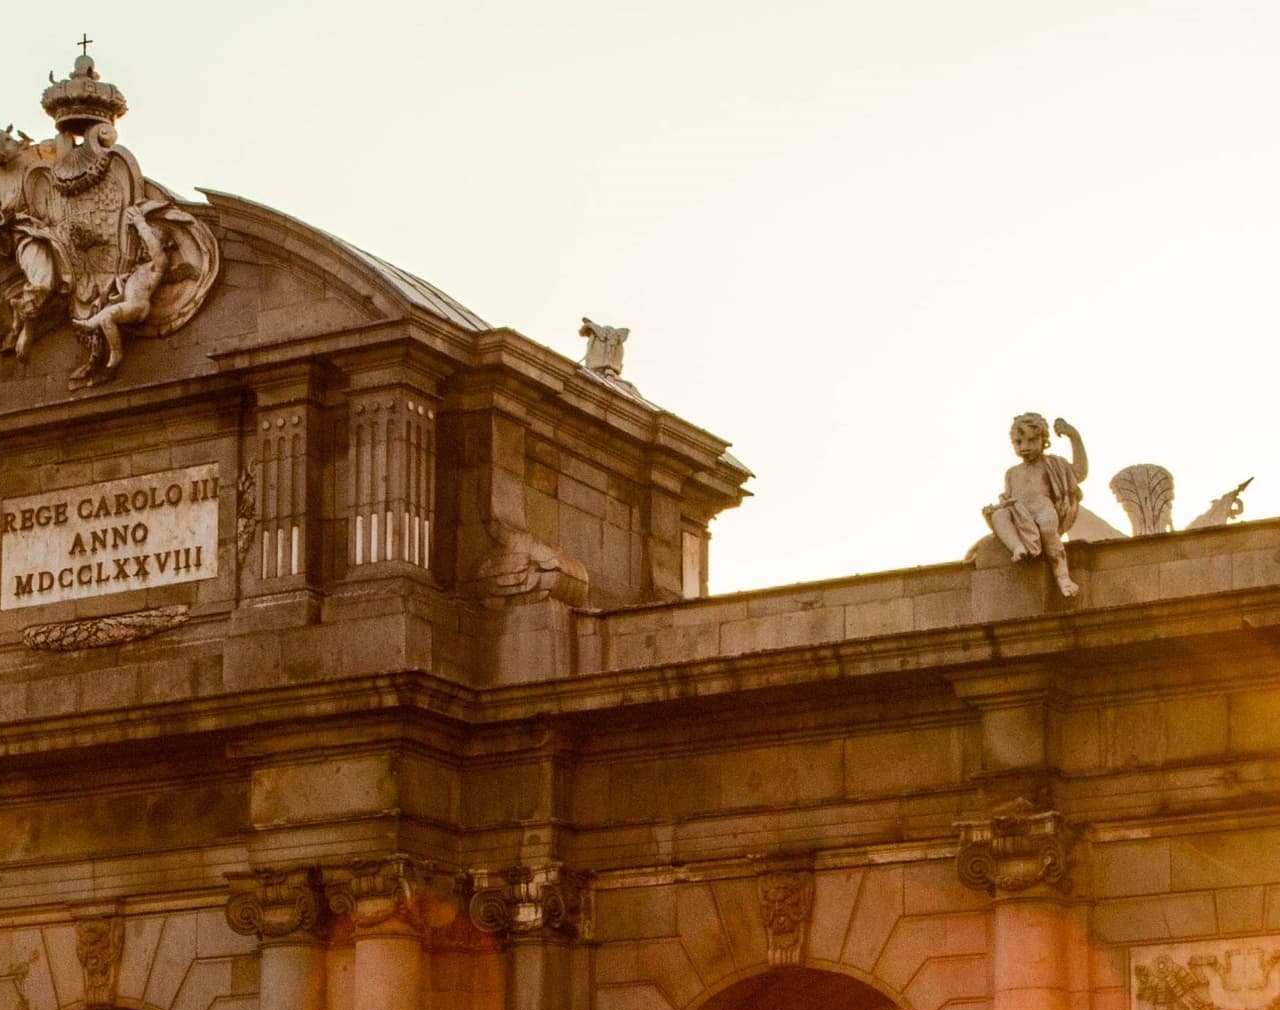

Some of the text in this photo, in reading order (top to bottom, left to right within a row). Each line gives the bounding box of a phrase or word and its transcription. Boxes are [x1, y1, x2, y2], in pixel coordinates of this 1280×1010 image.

[1, 477, 219, 533] REGE CAROLO III
[69, 522, 149, 555] ANNO
[14, 546, 203, 596] MDCCLXXVIII
